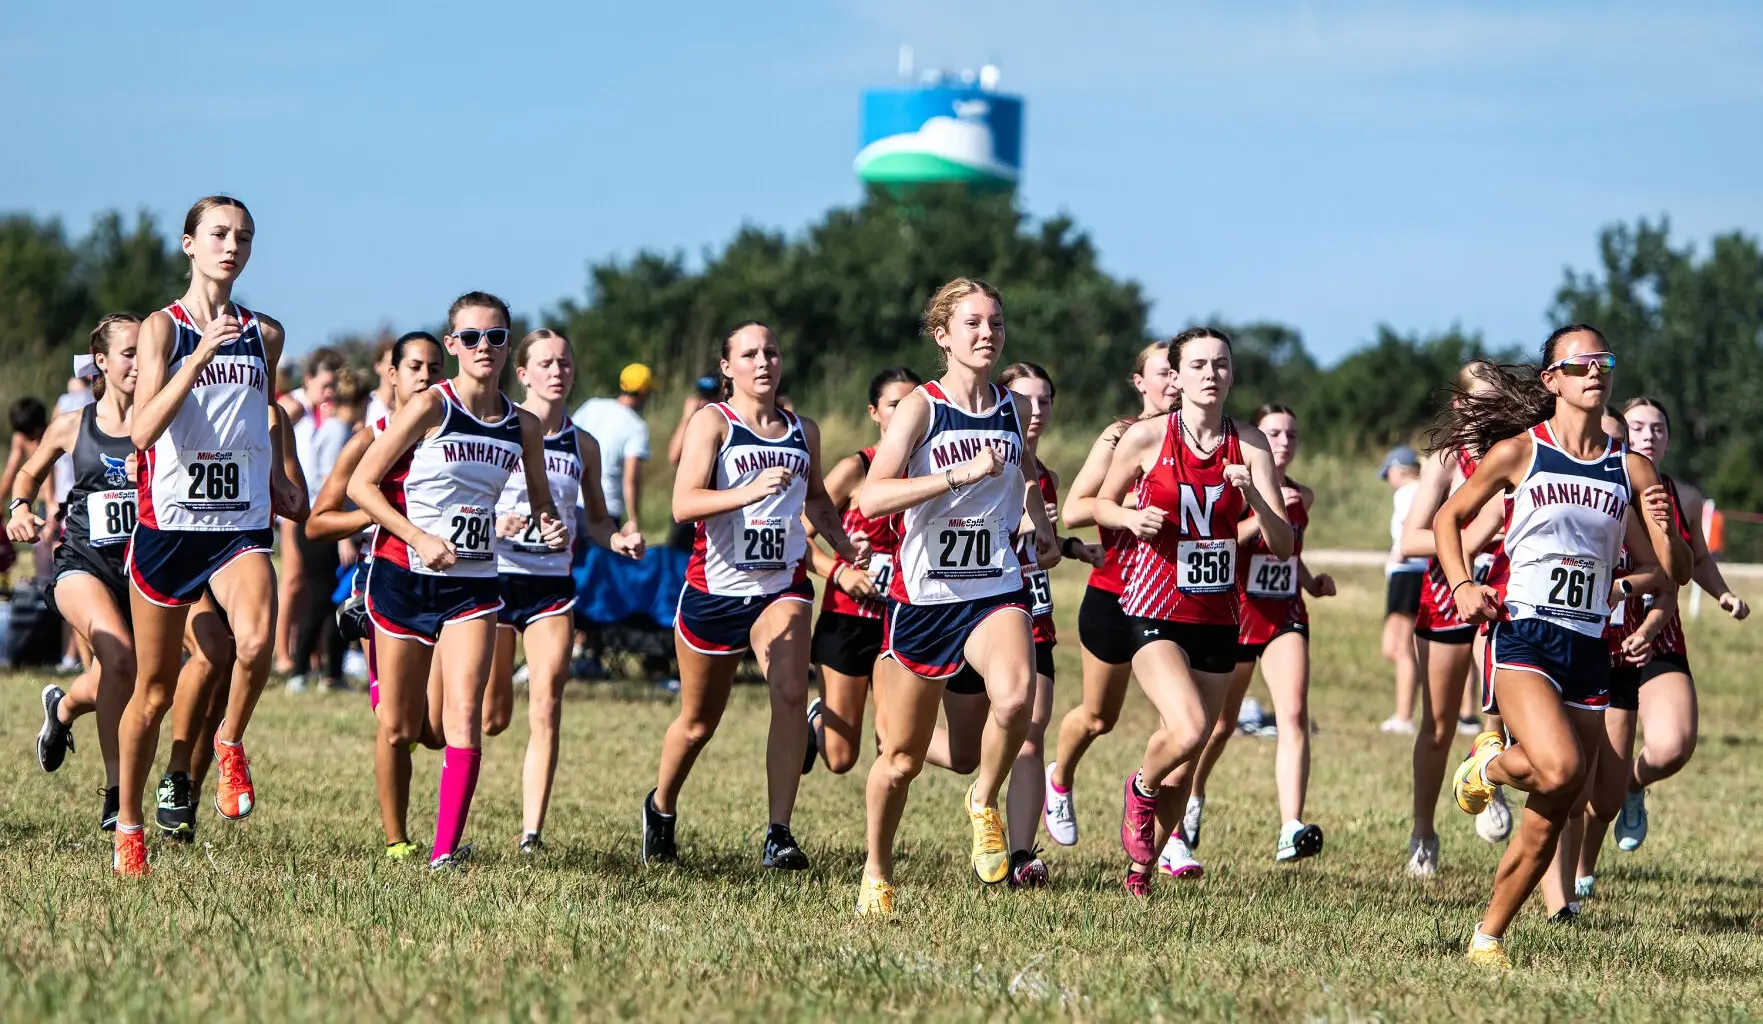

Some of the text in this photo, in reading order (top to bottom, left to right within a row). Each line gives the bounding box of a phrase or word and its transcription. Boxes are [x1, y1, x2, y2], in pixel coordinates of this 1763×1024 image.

[197, 452, 233, 462] MileSplit
[103, 491, 135, 500] MileSplit
[188, 463, 239, 499] 269
[460, 506, 488, 515] MileSplit
[1177, 481, 1226, 538] N
[1529, 482, 1627, 523] MANHATTAN
[450, 515, 490, 550] 284
[751, 518, 781, 526] MileSplit
[948, 518, 985, 529] MileSplit
[744, 528, 785, 560] 285
[939, 529, 991, 567] 270
[1195, 542, 1225, 550] MileSplit
[1187, 551, 1230, 584] 358
[1256, 564, 1292, 591] 423
[1561, 557, 1595, 569] MileSplit
[1548, 567, 1596, 610] 261
